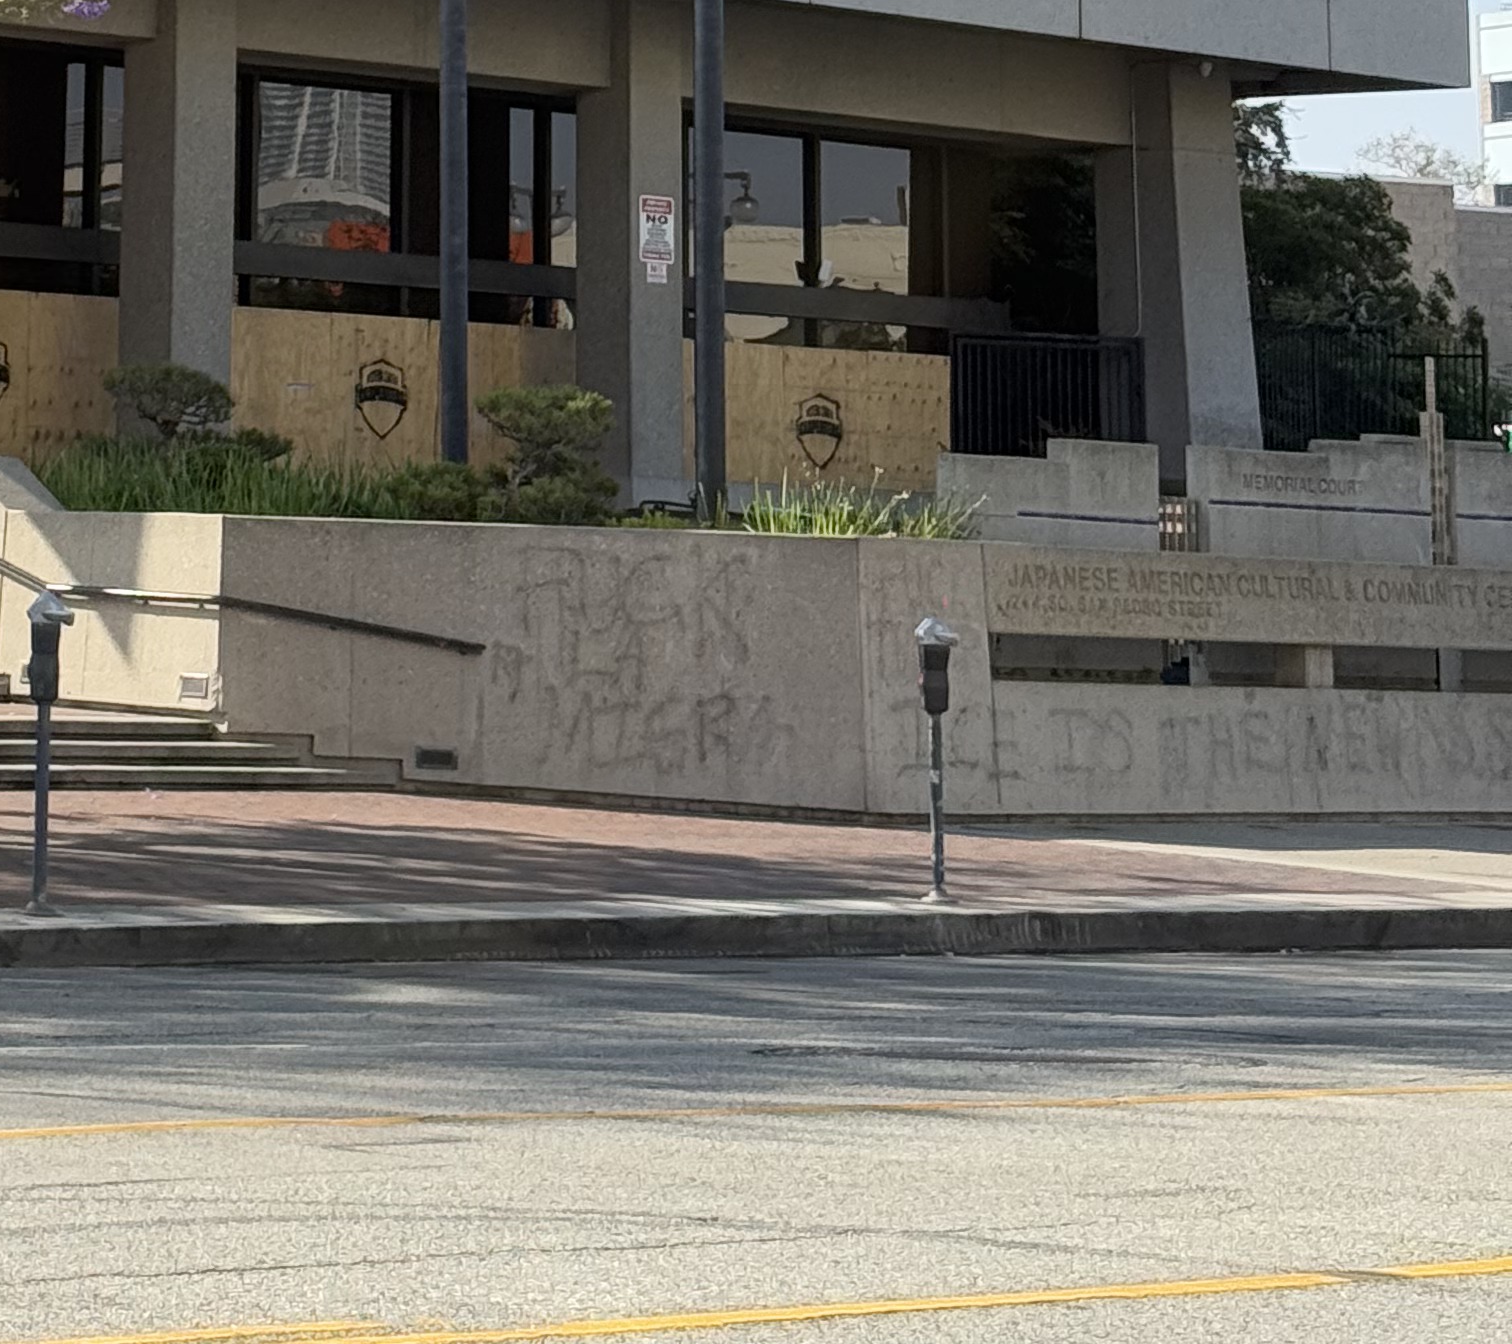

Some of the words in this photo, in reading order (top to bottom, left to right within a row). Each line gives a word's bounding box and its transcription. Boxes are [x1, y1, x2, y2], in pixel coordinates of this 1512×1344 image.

[646, 214, 669, 224] NO
[1242, 473, 1317, 495] MEMORIAL
[1007, 563, 1120, 593] JAPANESE
[1126, 569, 1233, 597] AMERICAN
[1237, 573, 1340, 602] CULTURAL
[1344, 578, 1356, 602] &
[1362, 578, 1479, 608] COMMUNITY
[1167, 600, 1224, 619] STREET
